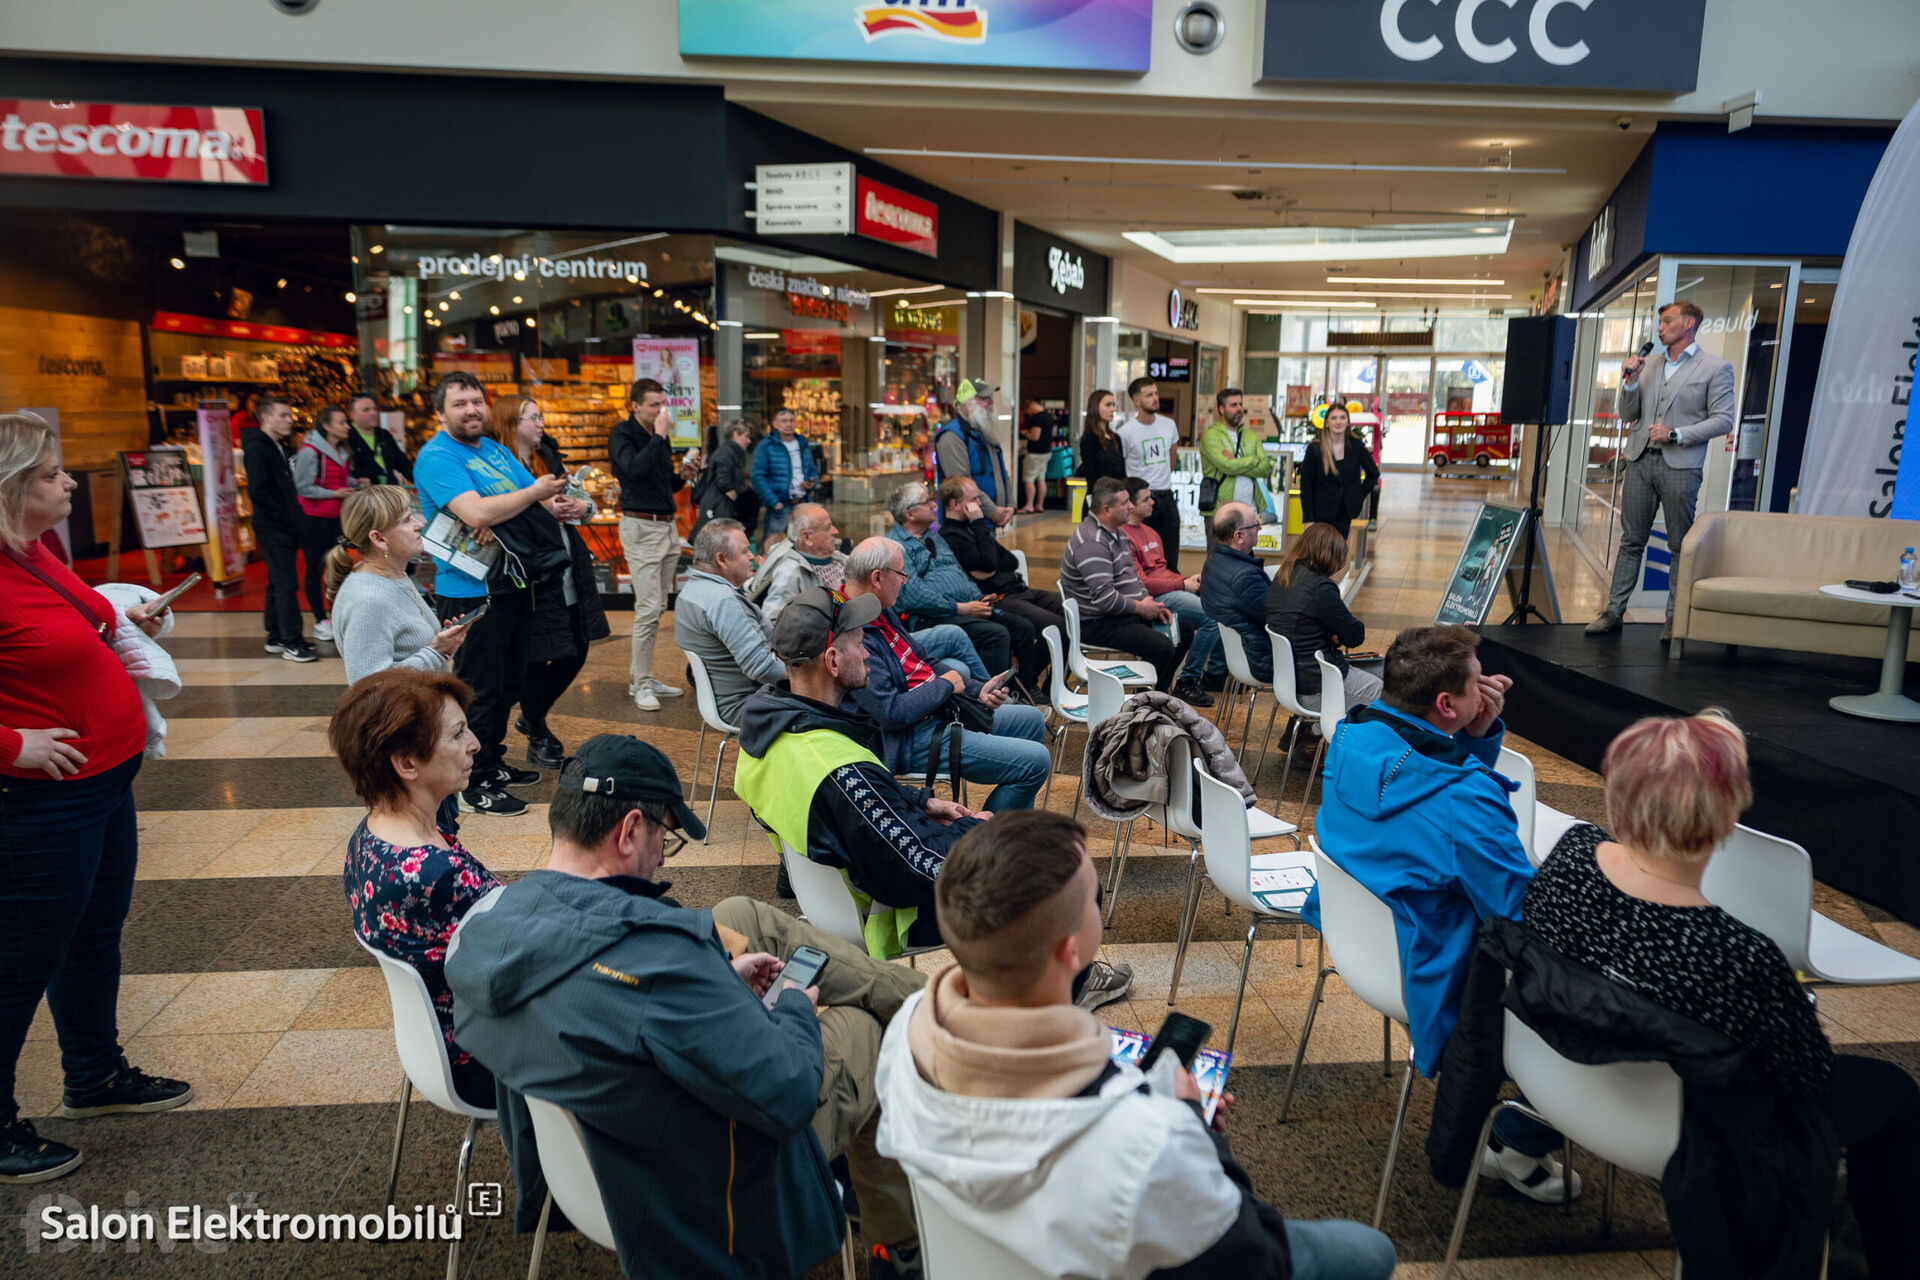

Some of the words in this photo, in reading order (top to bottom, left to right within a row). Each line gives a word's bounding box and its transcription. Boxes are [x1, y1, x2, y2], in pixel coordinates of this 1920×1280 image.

[1380, 0, 1592, 66] CCC
[0, 113, 235, 161] tescoma
[864, 190, 933, 239] tescoma
[538, 256, 648, 280] centrum
[748, 266, 785, 292] česká
[1048, 246, 1085, 295] Kebab
[1150, 362, 1167, 378] 31
[1150, 444, 1160, 458] N
